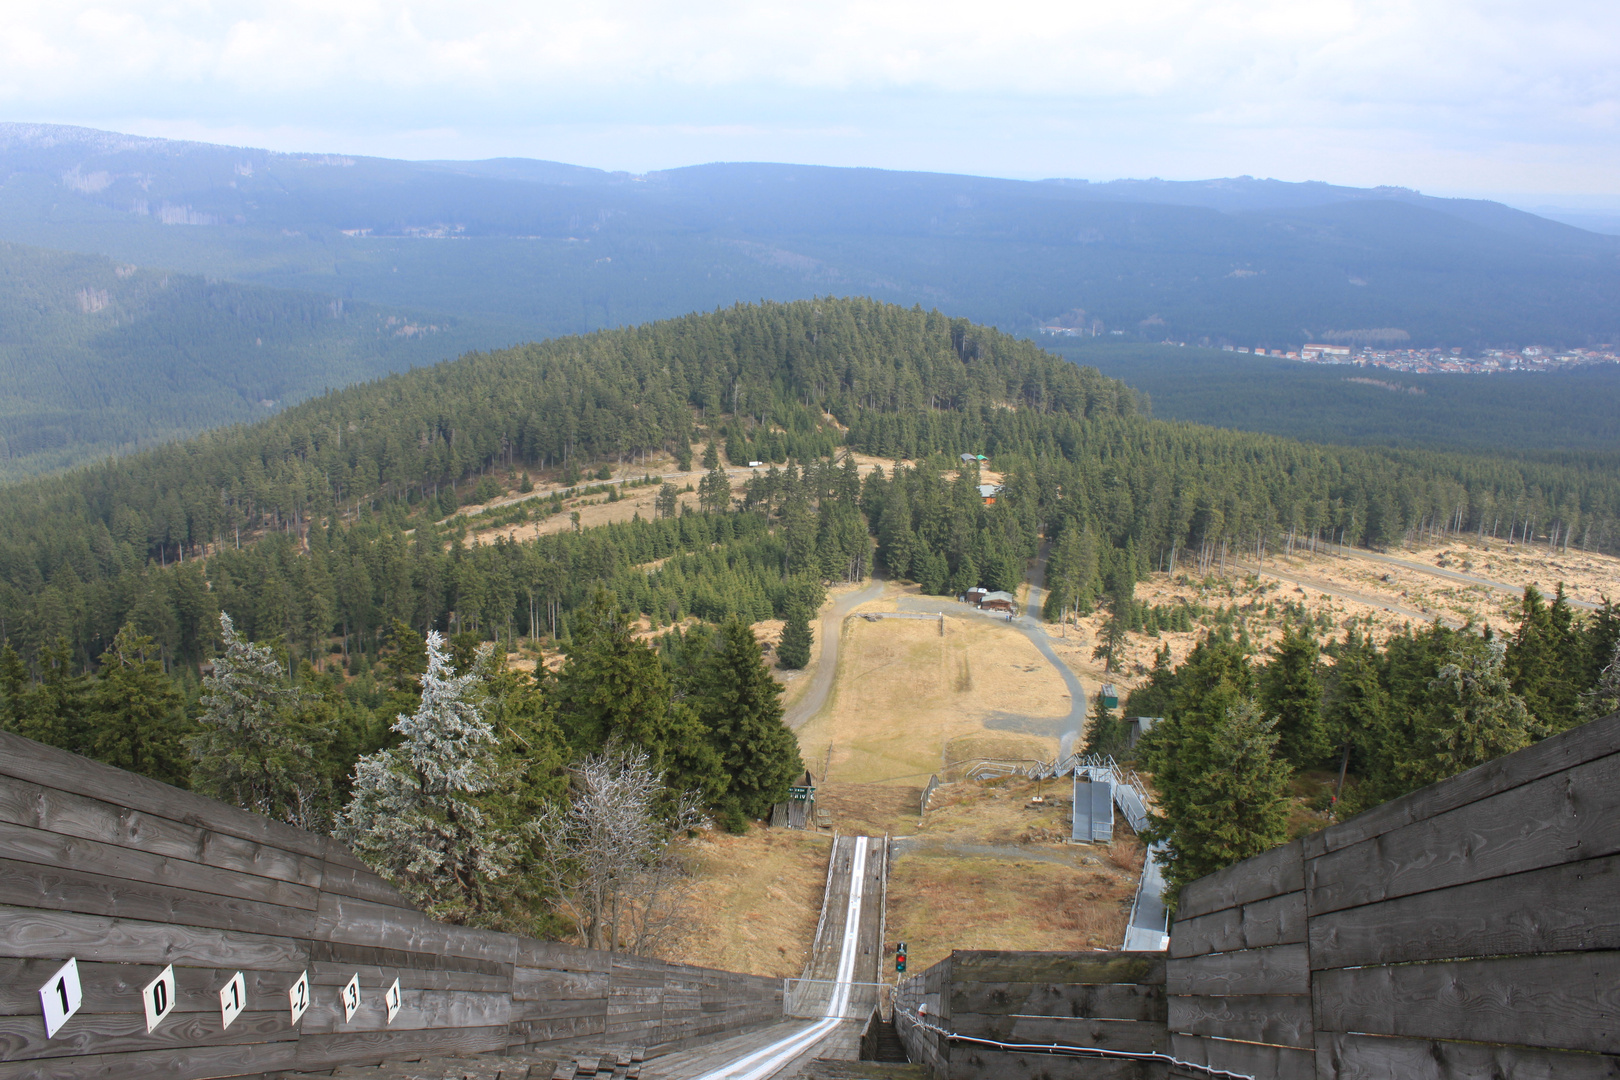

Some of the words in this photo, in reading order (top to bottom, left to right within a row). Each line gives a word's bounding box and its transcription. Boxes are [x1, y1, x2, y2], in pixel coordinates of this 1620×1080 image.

[56, 975, 70, 1016] 1
[153, 979, 167, 1016] 0
[225, 980, 239, 1011] -1
[293, 981, 306, 1011] -2
[346, 982, 357, 1010] -3
